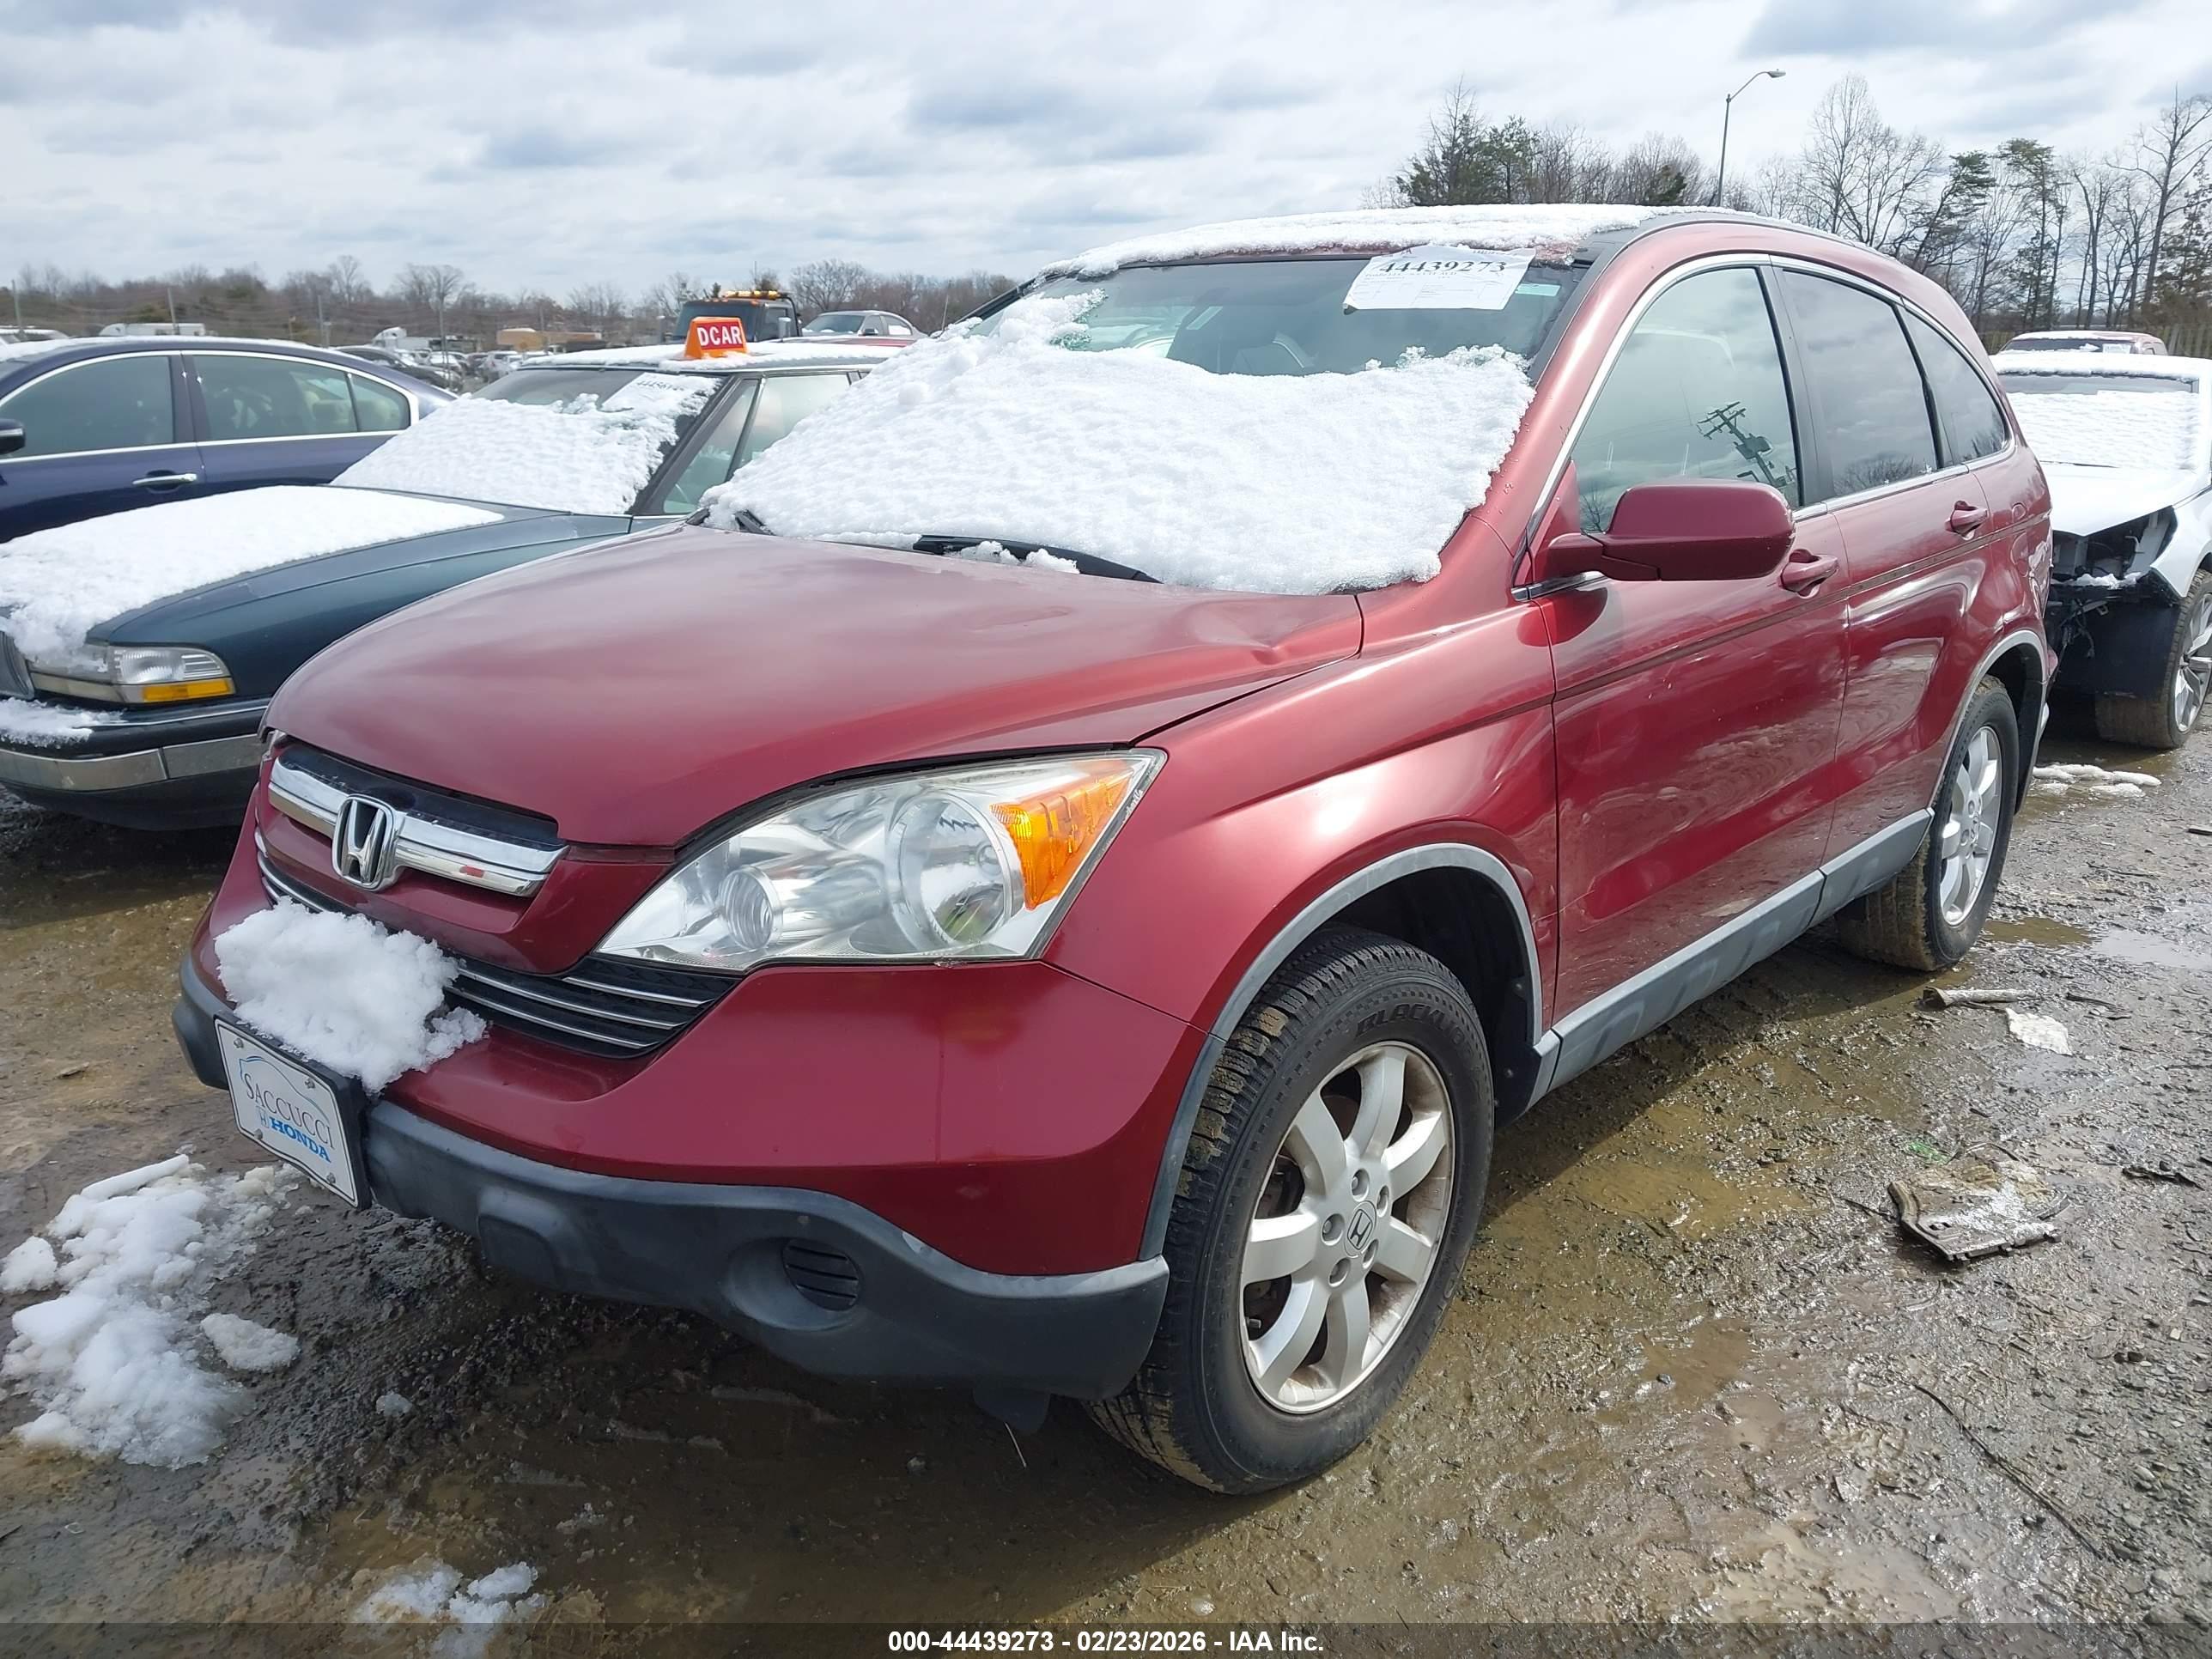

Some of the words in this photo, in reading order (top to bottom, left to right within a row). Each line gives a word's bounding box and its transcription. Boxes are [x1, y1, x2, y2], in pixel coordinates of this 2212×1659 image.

[1379, 260, 1507, 273] 44439273
[696, 325, 743, 346] DCAR
[245, 1073, 335, 1151] SACCUCCI
[269, 1116, 332, 1164] HONDA
